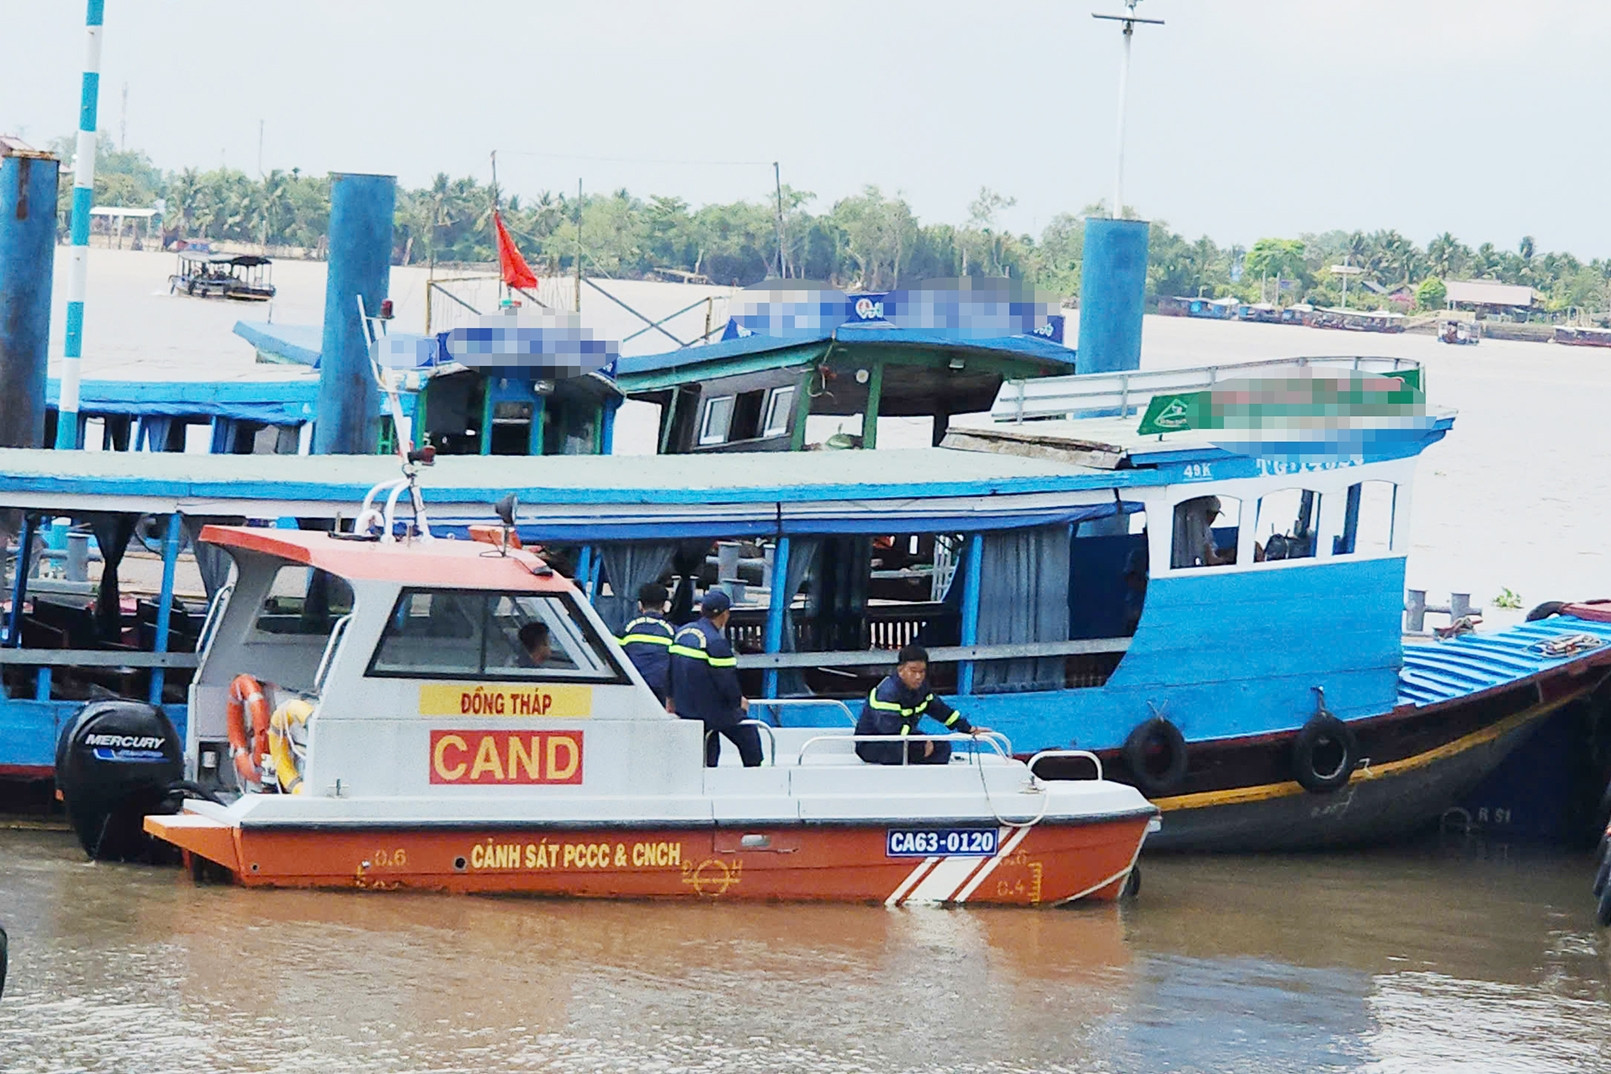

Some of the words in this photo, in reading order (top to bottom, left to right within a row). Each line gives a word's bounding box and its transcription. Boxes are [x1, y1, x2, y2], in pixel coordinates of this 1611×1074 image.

[1183, 463, 1212, 478] 49K
[461, 686, 505, 714] ĐỒNG
[510, 688, 552, 715] THÁP
[84, 734, 165, 749] MERCURY
[434, 734, 580, 781] CAND
[471, 838, 520, 868] CẢNH
[525, 838, 559, 868] SÁT
[563, 844, 610, 868] PCCC
[614, 843, 628, 867] &
[632, 842, 682, 867] CNCH
[890, 832, 994, 853] CA63-0120
